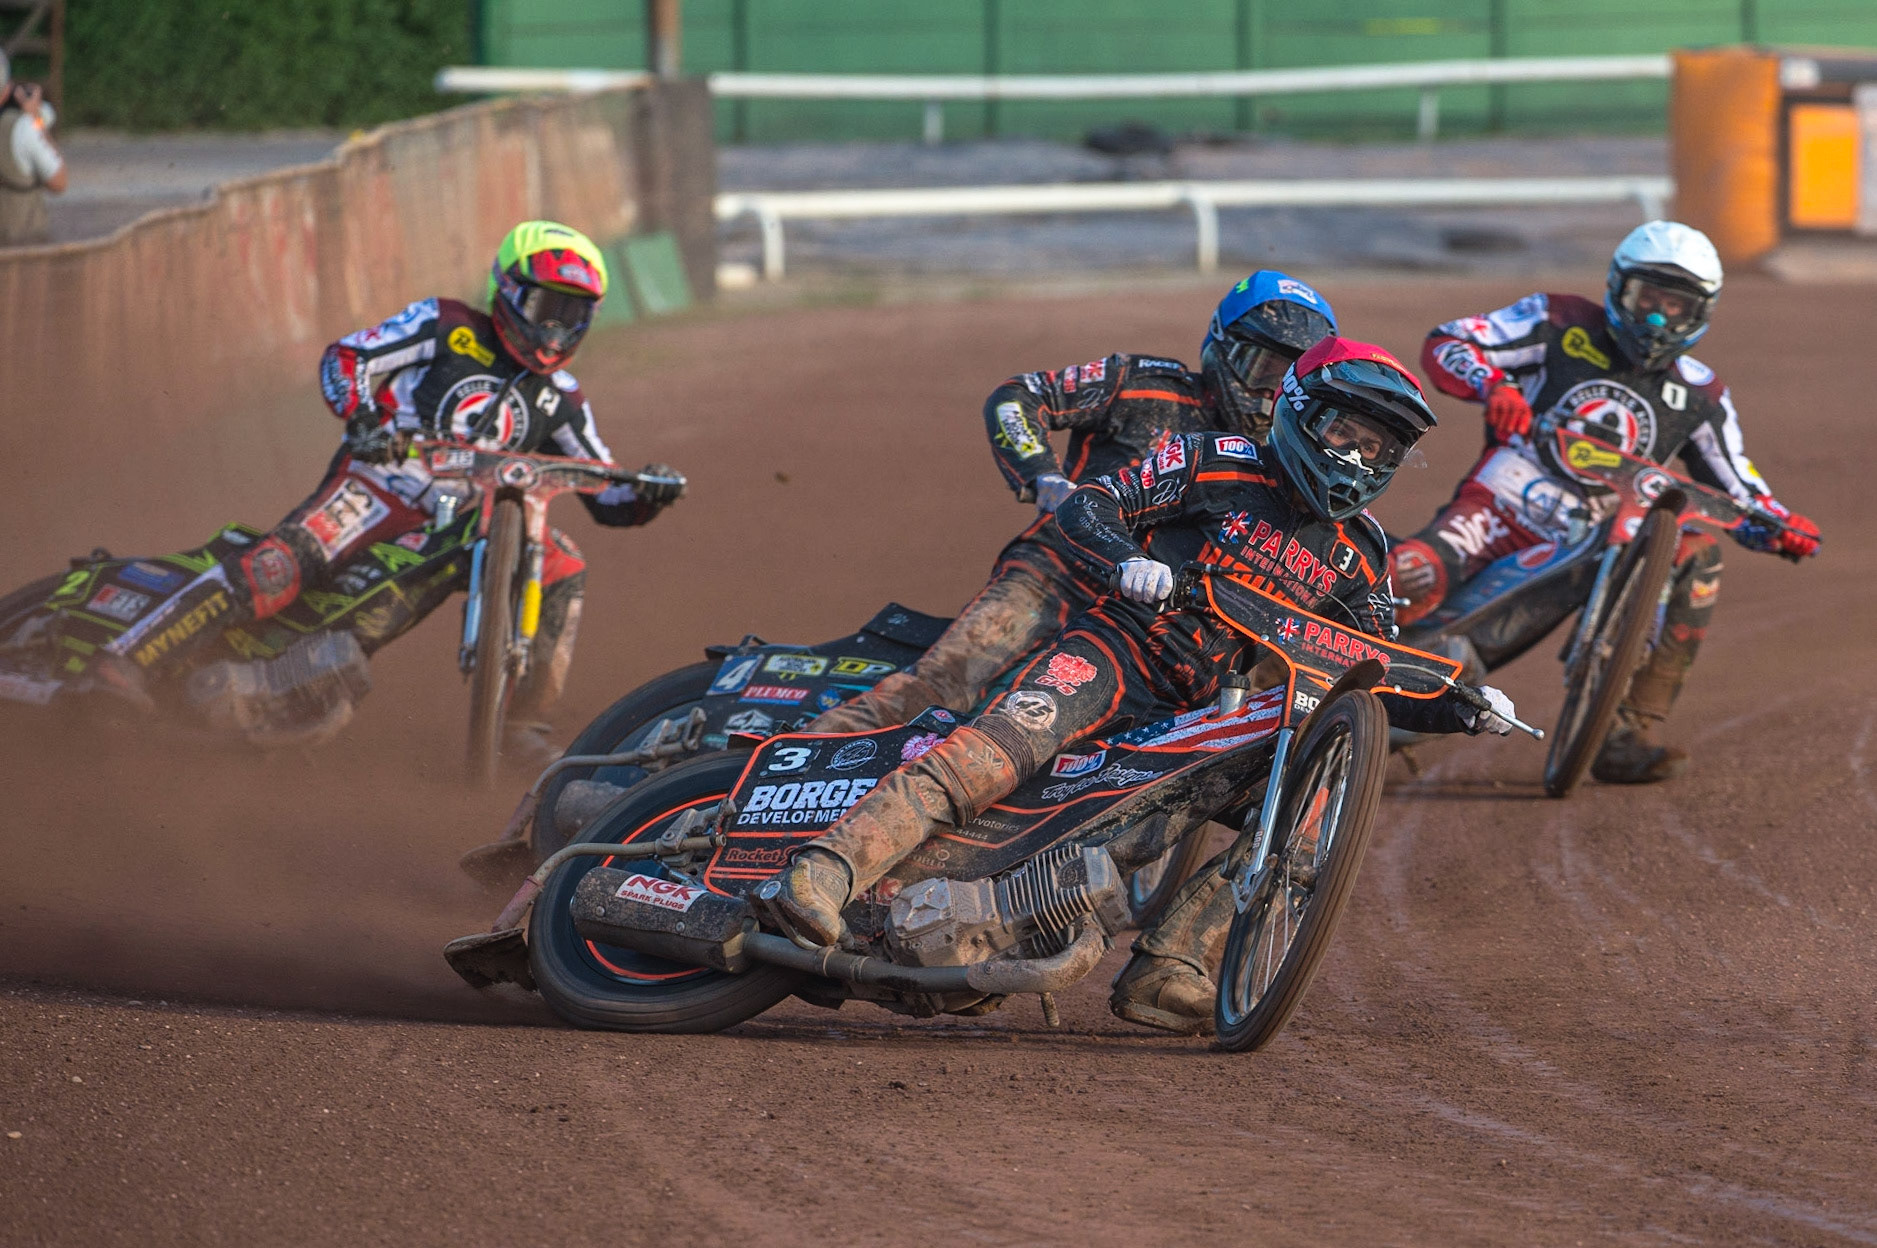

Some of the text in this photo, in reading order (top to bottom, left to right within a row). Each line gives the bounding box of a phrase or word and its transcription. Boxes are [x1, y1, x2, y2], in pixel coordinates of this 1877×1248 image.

[1223, 440, 1253, 456] 100%
[1248, 519, 1337, 597] PARRYS
[1338, 547, 1353, 571] 3
[715, 659, 757, 690] 4
[768, 747, 812, 771] 3
[627, 875, 702, 900] NGK
[621, 890, 685, 910] SPARK PLUGS
